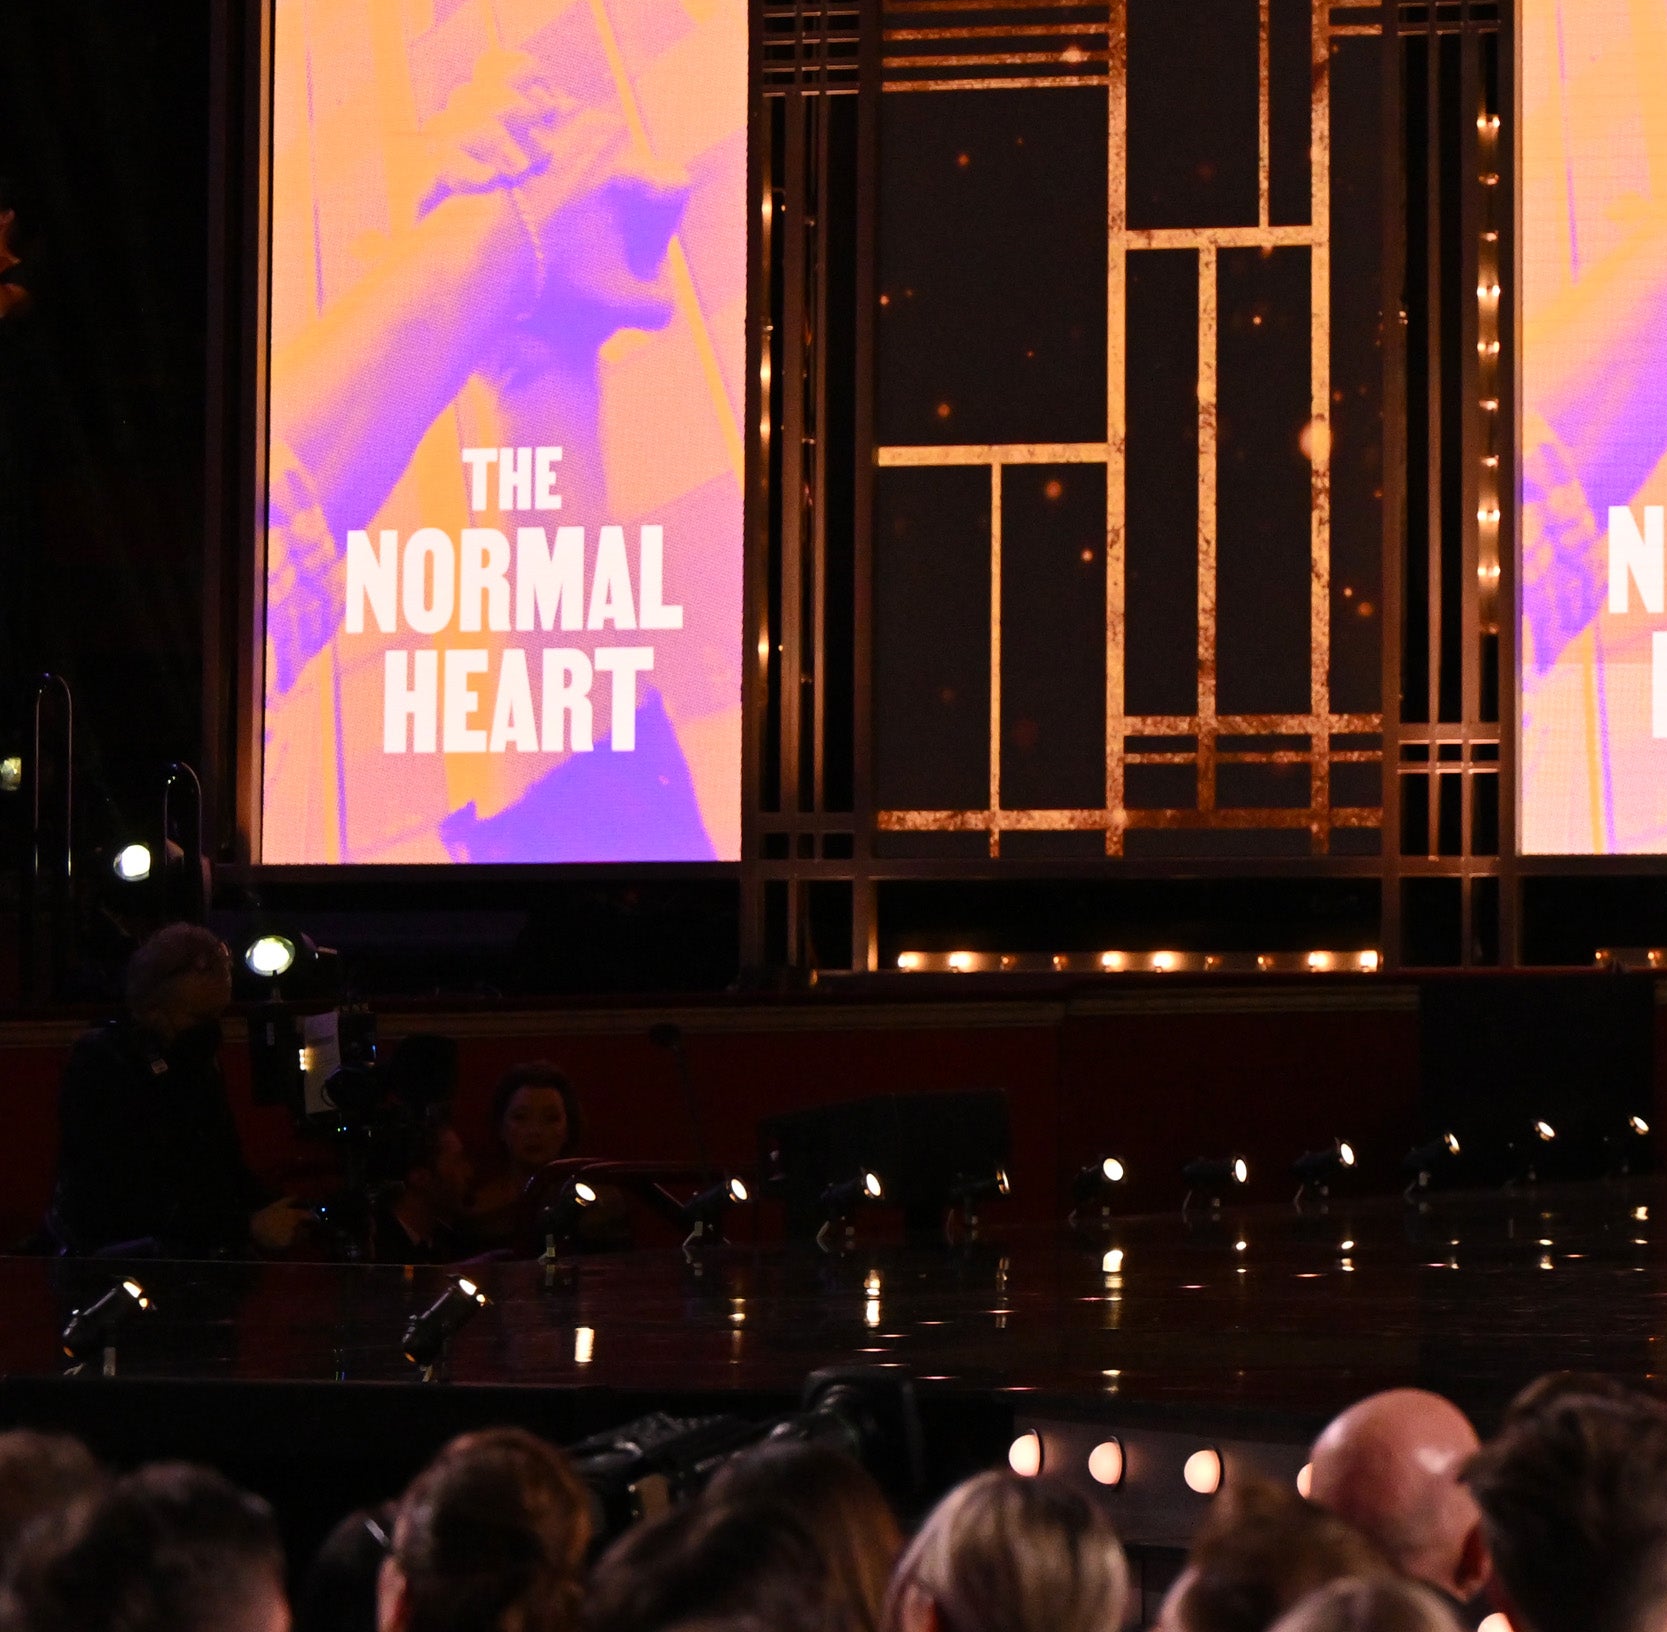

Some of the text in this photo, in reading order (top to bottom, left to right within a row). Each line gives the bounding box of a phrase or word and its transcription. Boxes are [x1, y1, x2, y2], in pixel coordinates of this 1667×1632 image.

[462, 446, 563, 512] THE
[345, 524, 684, 634] NORMAL
[382, 646, 655, 755] HEART
